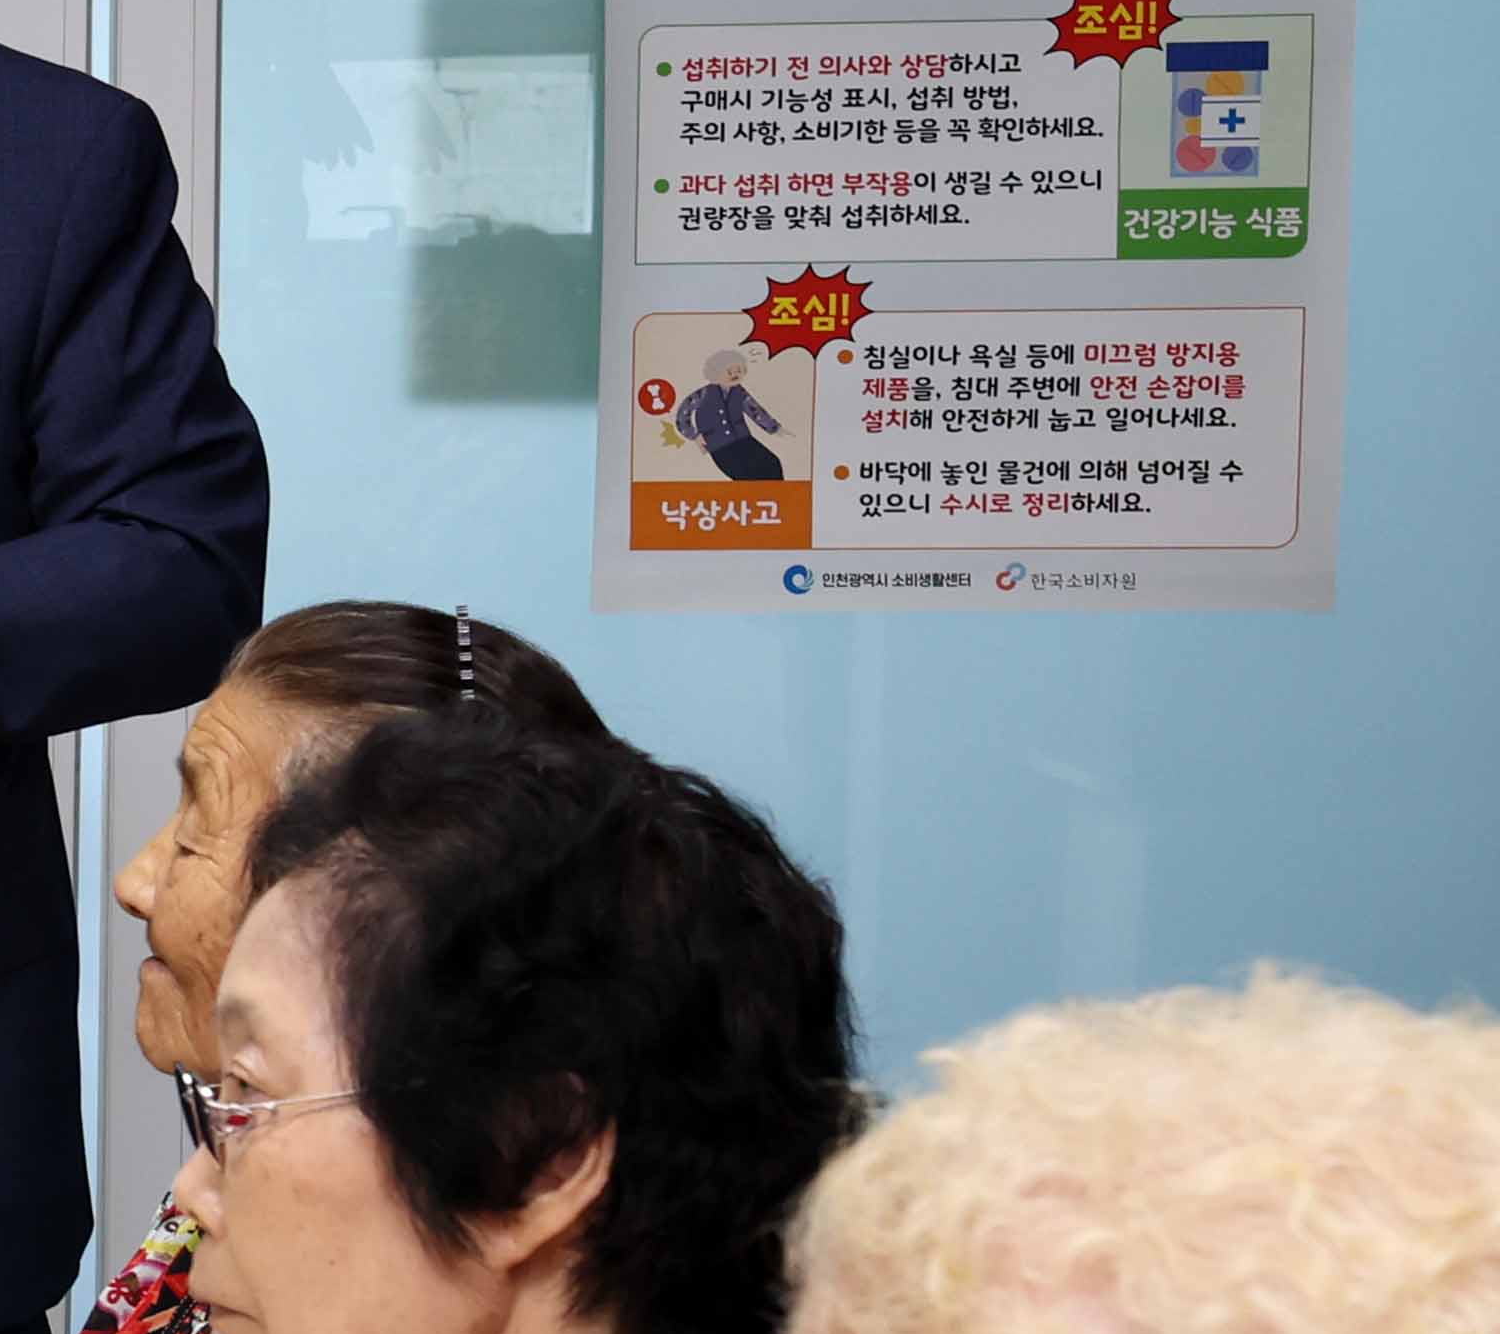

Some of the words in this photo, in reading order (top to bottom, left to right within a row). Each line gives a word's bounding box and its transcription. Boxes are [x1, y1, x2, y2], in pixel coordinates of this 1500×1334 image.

[1073, 2, 1157, 41] 조심!
[682, 57, 776, 82] 섭취하기
[788, 56, 808, 80] 전
[819, 55, 892, 76] 의사와
[900, 53, 1021, 79] 상담하시고
[681, 90, 751, 113] 구매시
[762, 89, 832, 113] 기능성
[842, 88, 896, 110] 표시,
[907, 86, 953, 111] 섭취
[964, 86, 1017, 110] 방법,
[680, 122, 725, 145] 주의
[733, 121, 785, 145] 사항,
[792, 119, 887, 144] 소비기한
[894, 119, 940, 144] 등을
[948, 119, 971, 142] 꼭
[978, 117, 1103, 142] 확인하세요.
[679, 175, 726, 195] 과다
[734, 174, 779, 198] 섭취
[788, 173, 833, 197] 하면
[842, 172, 935, 196] 부작용이
[945, 171, 990, 195] 생길
[1000, 171, 1023, 193] 수
[1031, 170, 1101, 194] 있으니
[785, 205, 830, 229] 맞춰
[842, 204, 969, 229] 섭취하세요.
[1122, 208, 1238, 240] 건강기능
[1246, 205, 1304, 239] 식품
[768, 293, 851, 332] 조심!
[864, 345, 961, 369] 침실이나
[969, 345, 1016, 368] 욕실
[1026, 344, 1074, 369] 등에
[1085, 343, 1156, 367] 미끄럼
[1167, 342, 1239, 367] 방지용
[863, 377, 941, 401] 제품을,
[952, 377, 998, 401] 침대
[1007, 376, 1080, 400] 주변에
[1090, 376, 1137, 399] 안전
[1148, 375, 1245, 399] 손잡이를
[862, 409, 932, 433] 설치해
[942, 408, 1038, 432] 안전하게
[1048, 409, 1096, 432] 눕고
[1106, 407, 1236, 431] 일어나세요.
[860, 462, 931, 485] 바닥에
[940, 461, 987, 486] 놓인
[998, 461, 1069, 485] 물건에
[1079, 460, 1127, 481] 의해
[1138, 460, 1209, 484] 넘어질
[1220, 460, 1243, 482] 수
[661, 498, 782, 531] 낙상사고
[860, 494, 929, 517] 있으니
[940, 493, 1012, 515] 수시로
[1023, 492, 1150, 517] 정리하세요.
[823, 572, 888, 588] 인천광역시
[892, 571, 971, 588] 소비생활센터
[1031, 572, 1136, 592] 한국소비자원
